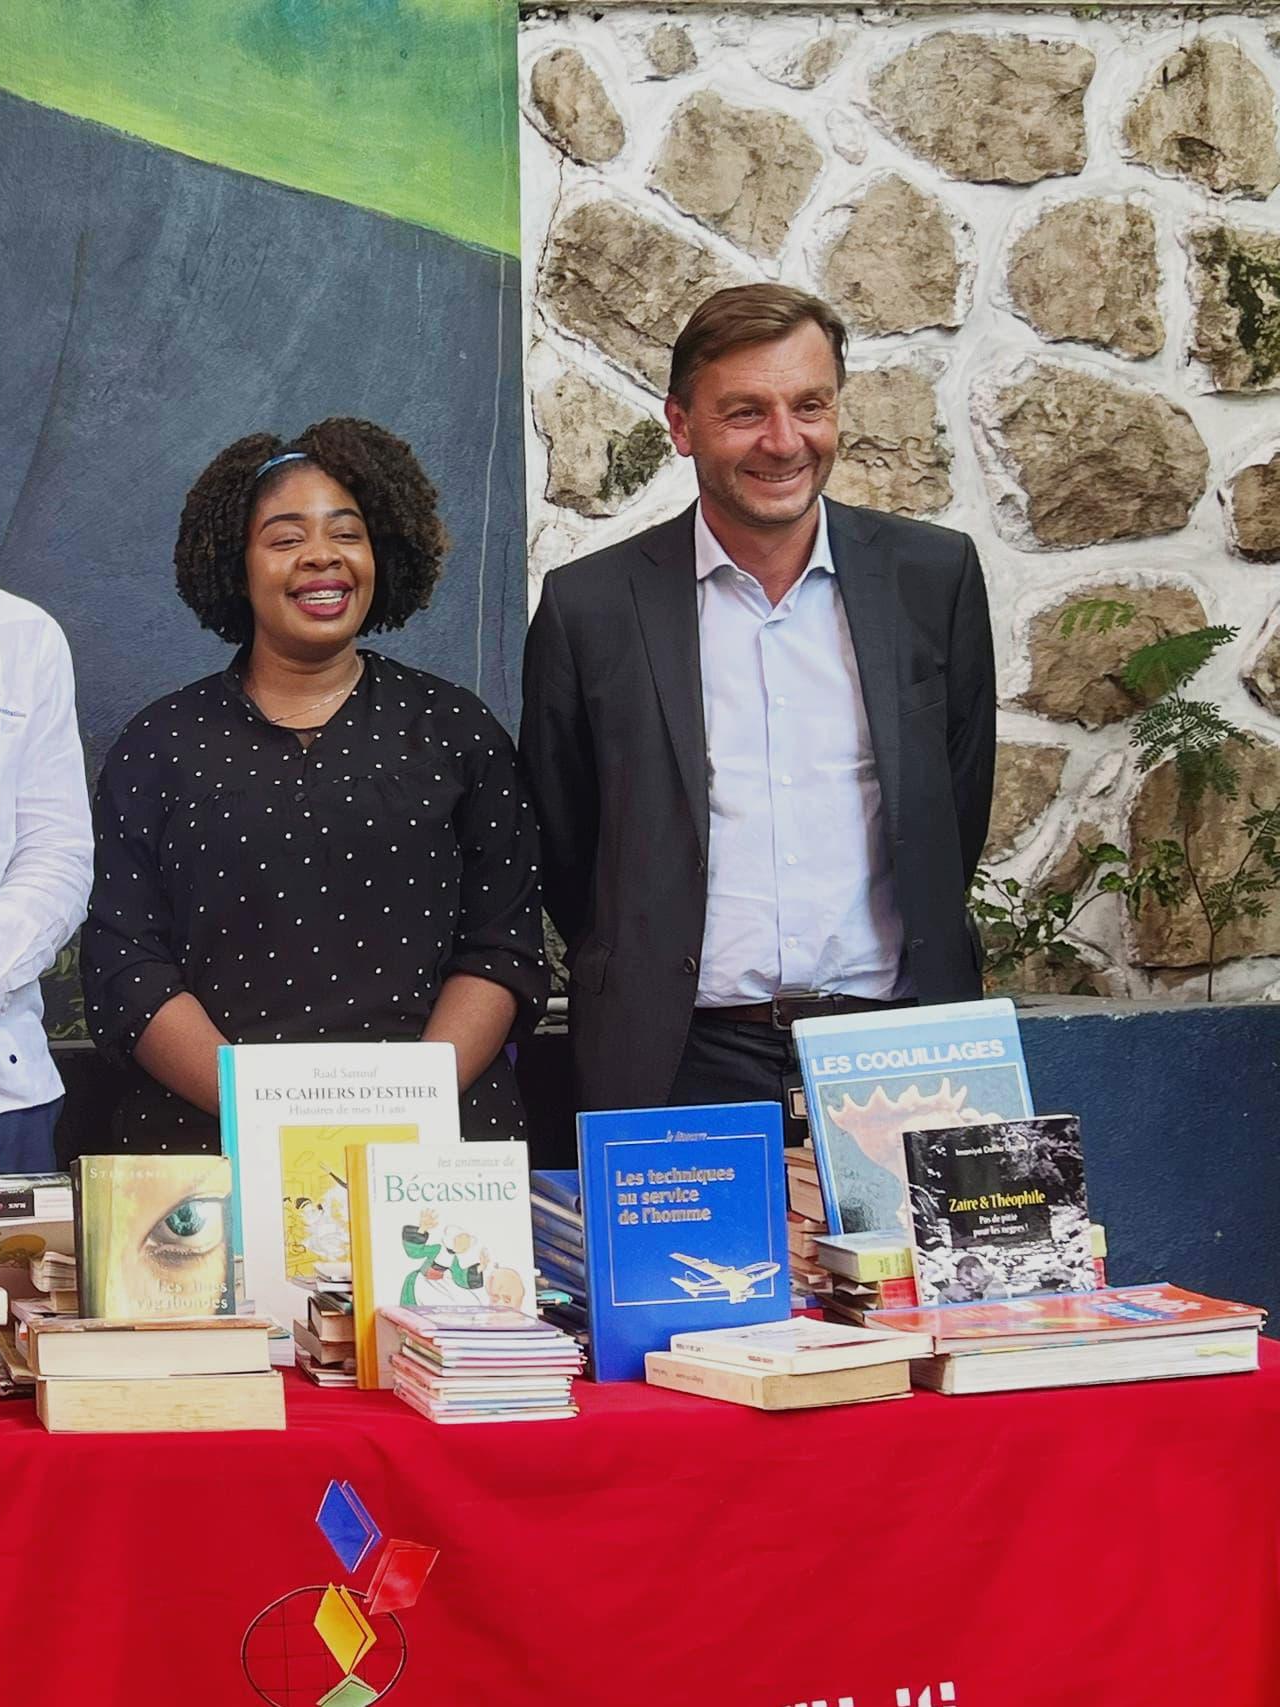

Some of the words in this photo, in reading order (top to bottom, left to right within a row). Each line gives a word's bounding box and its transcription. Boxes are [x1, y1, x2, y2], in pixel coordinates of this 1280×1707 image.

[810, 1055, 853, 1076] LES
[855, 1038, 1006, 1072] COQUILLAGES
[313, 1067, 337, 1080] Riad
[254, 1087, 283, 1101] LES
[286, 1087, 356, 1101] CAHIERS
[359, 1085, 439, 1100] D'ESTHER
[615, 1170, 644, 1187] Les
[647, 1165, 736, 1186] techniques
[384, 1172, 518, 1203] Bécassine
[617, 1192, 638, 1206] au
[640, 1187, 700, 1204] service
[979, 1195, 989, 1210] &
[990, 1189, 1046, 1208] Théophile
[618, 1209, 639, 1225] de
[641, 1205, 712, 1225] l'homme
[978, 1215, 992, 1225] Pas
